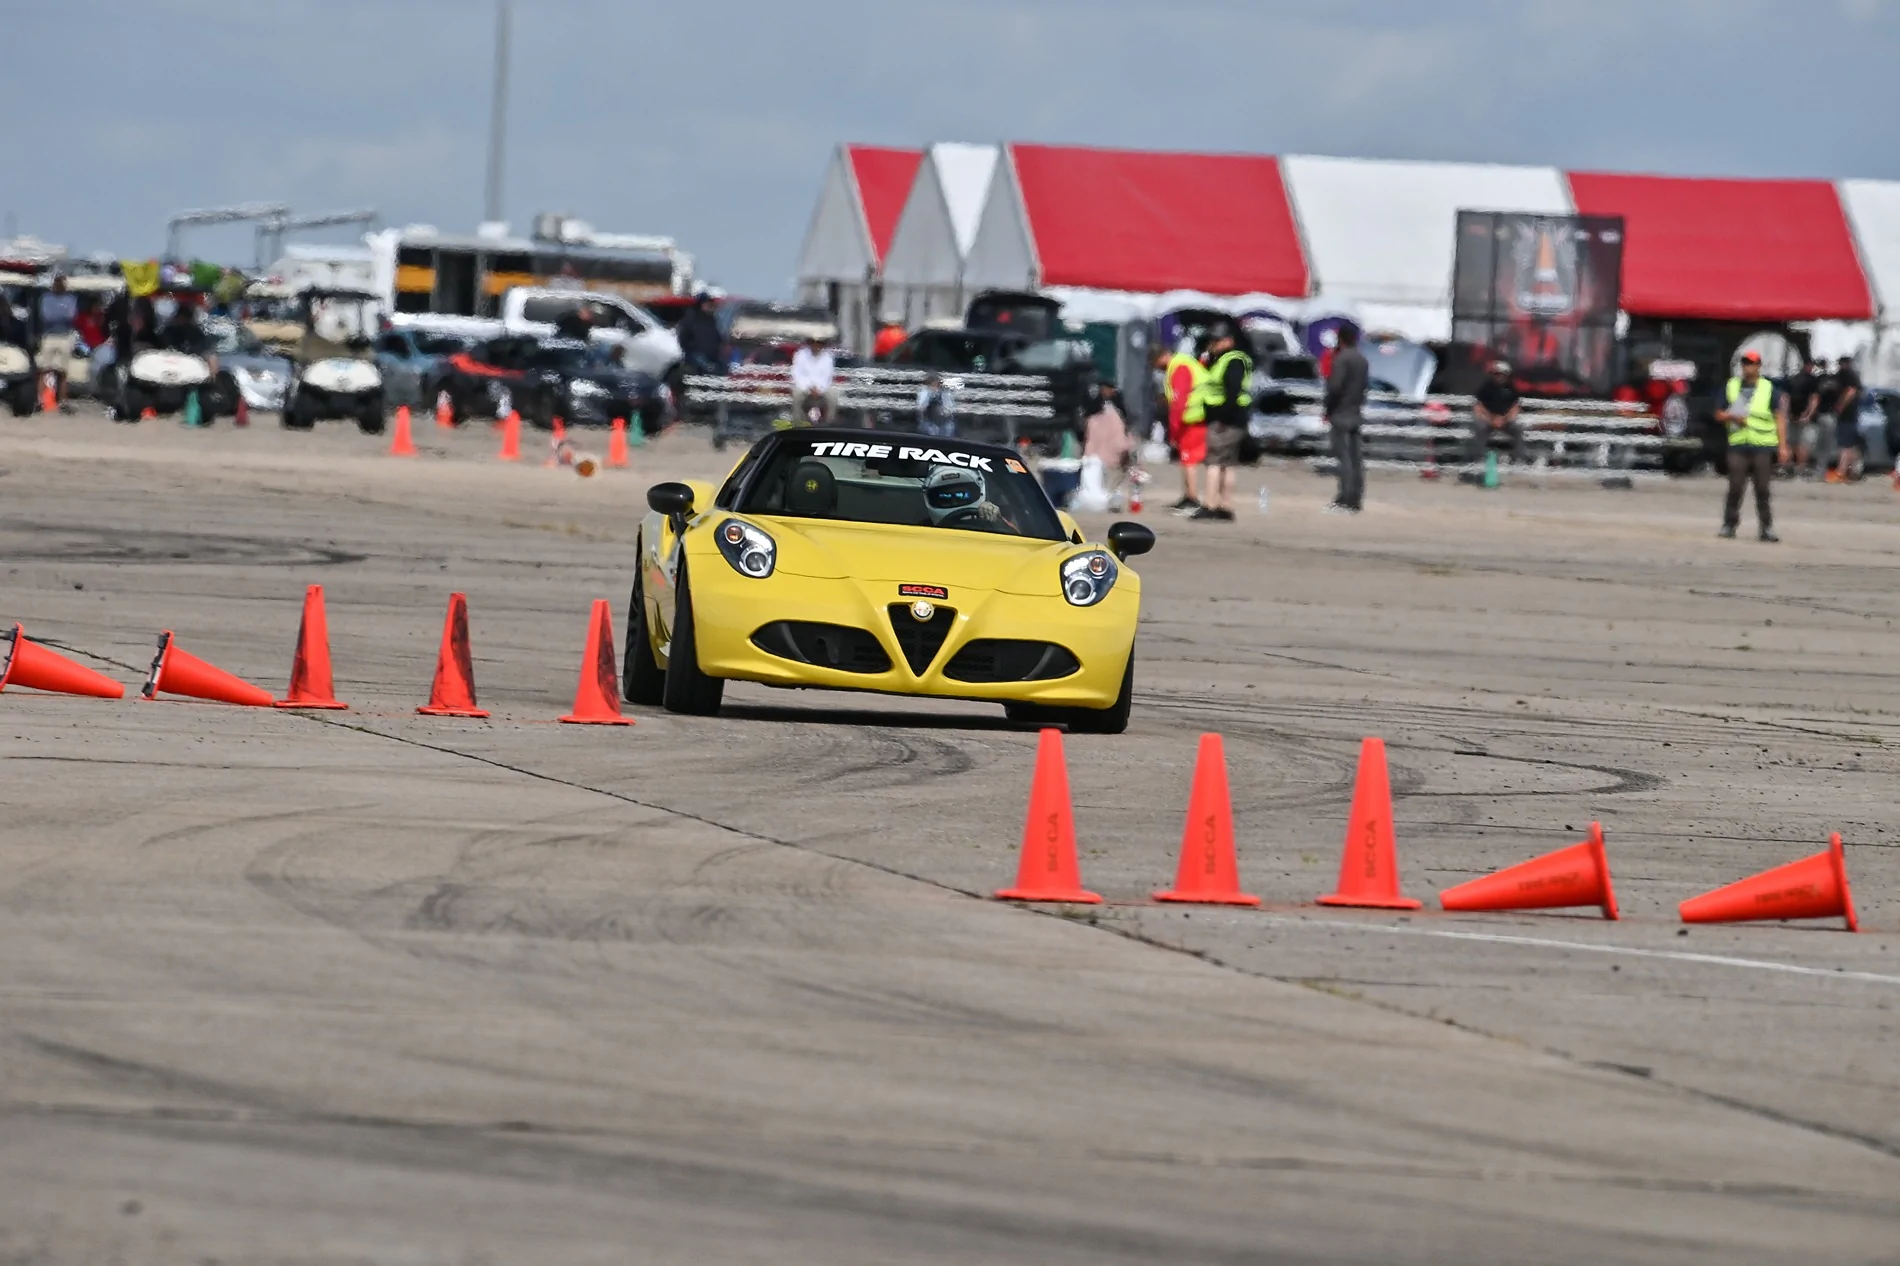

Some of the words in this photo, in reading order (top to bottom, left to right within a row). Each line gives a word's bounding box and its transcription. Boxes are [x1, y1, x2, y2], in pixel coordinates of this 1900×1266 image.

[811, 442, 892, 459] TIRE
[899, 447, 993, 473] RACK
[902, 585, 945, 595] SCCA
